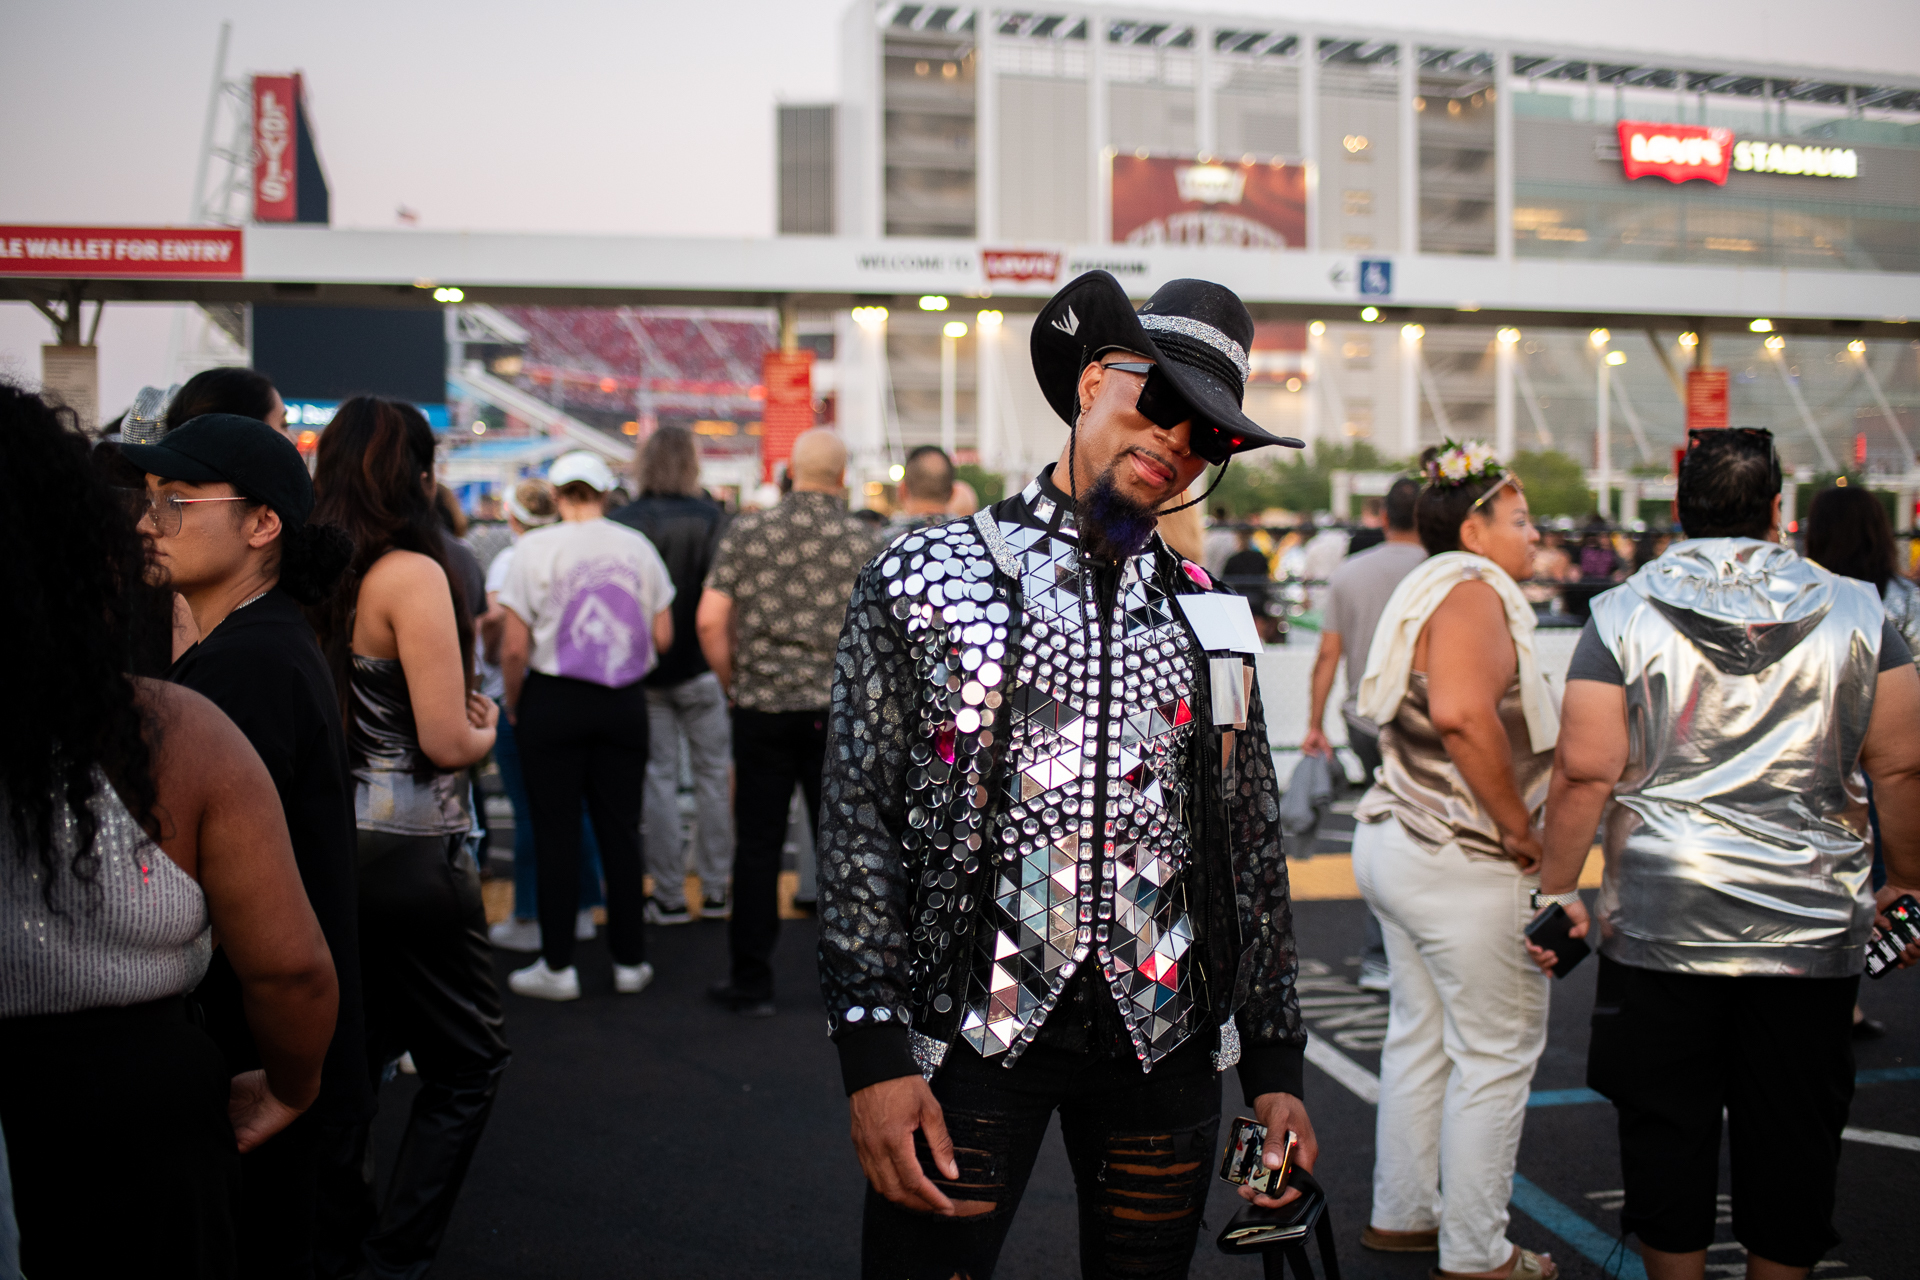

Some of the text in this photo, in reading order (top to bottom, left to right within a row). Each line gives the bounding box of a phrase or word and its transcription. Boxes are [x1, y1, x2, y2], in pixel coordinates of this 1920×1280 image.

[1733, 141, 1858, 178] STADIUM
[26, 238, 112, 260] WALLET
[114, 240, 159, 261] FOR
[162, 240, 232, 262] ENTRY
